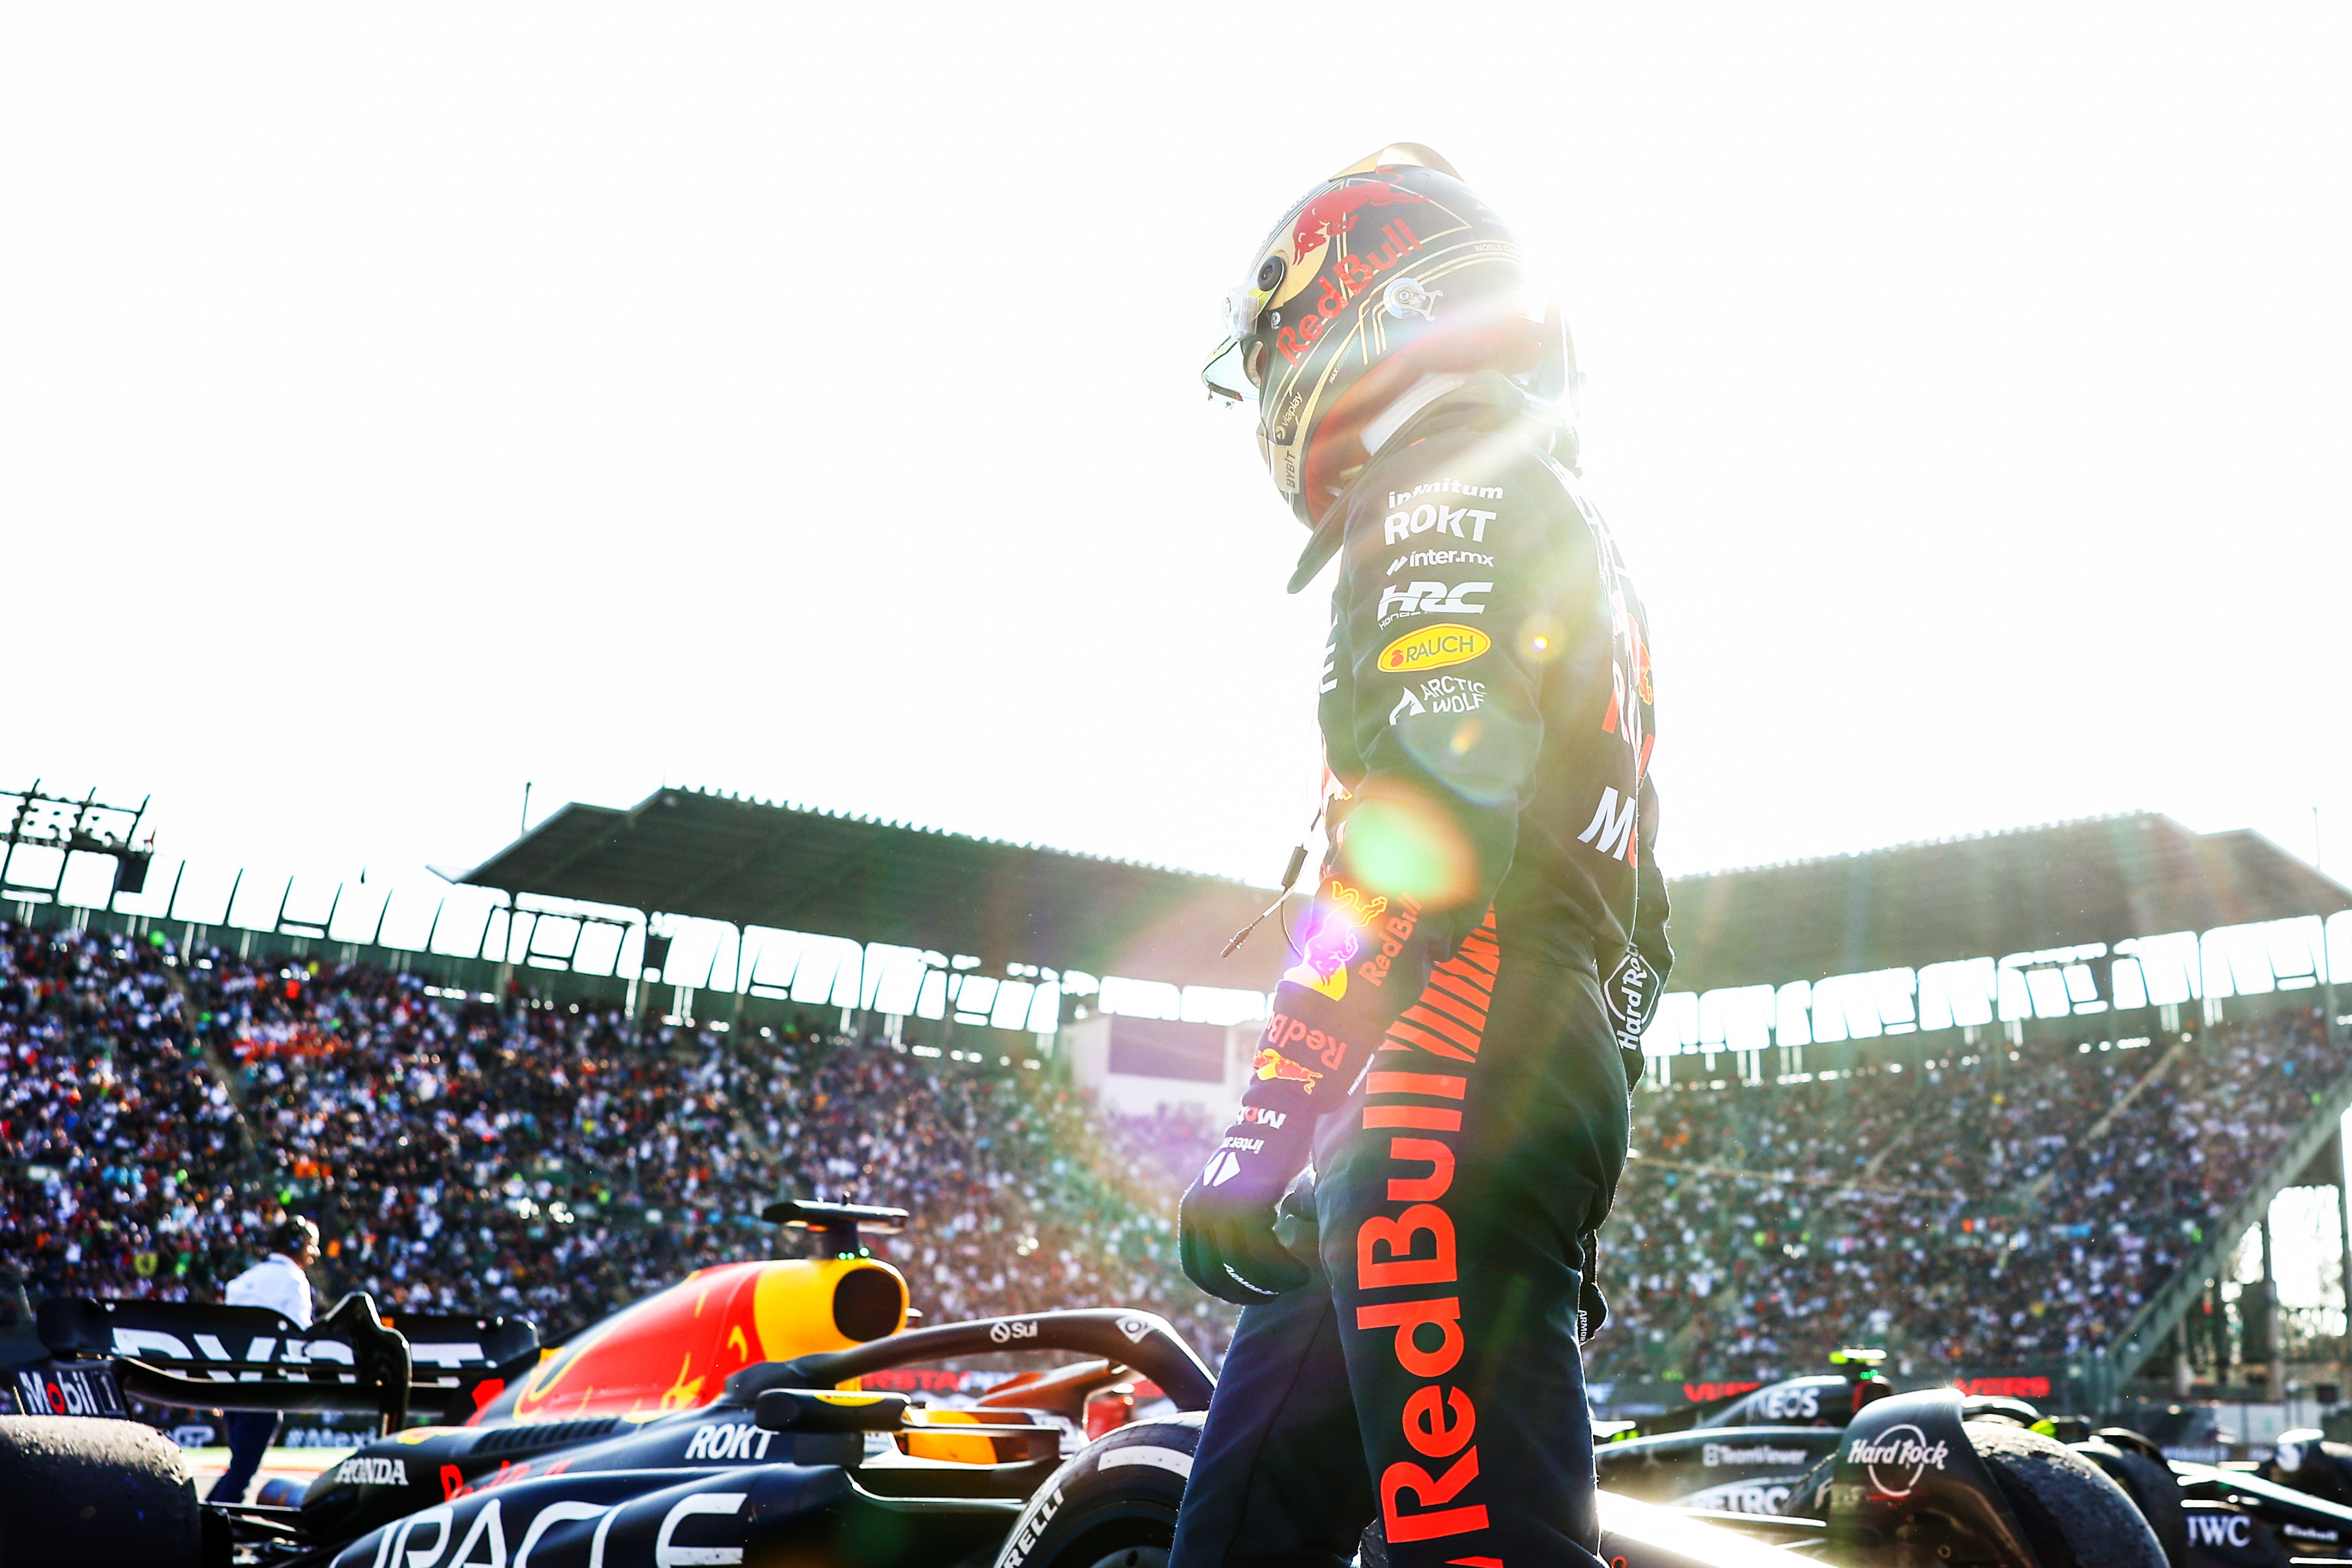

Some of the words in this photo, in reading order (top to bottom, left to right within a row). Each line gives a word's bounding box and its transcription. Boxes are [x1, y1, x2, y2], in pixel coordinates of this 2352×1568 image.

[1474, 243, 1503, 254] WORLD
[1282, 391, 1303, 427] viaplay
[1285, 450, 1296, 488] BYBIT
[1384, 503, 1497, 545] ROKT
[1377, 582, 1493, 621] HRC
[1406, 635, 1473, 663] RAUCH
[1420, 675, 1487, 701] ARCTIC
[1433, 692, 1484, 713] WOLF
[1616, 986, 1642, 1051] Hard
[1011, 1320, 1038, 1339] Sui
[19, 1371, 100, 1415] Mobil
[684, 1424, 780, 1460] ROKT
[1847, 1439, 1901, 1463] Hard
[1898, 1439, 1949, 1470] Rock
[335, 1458, 409, 1485] HONDA
[2186, 1515, 2250, 1548] IWC
